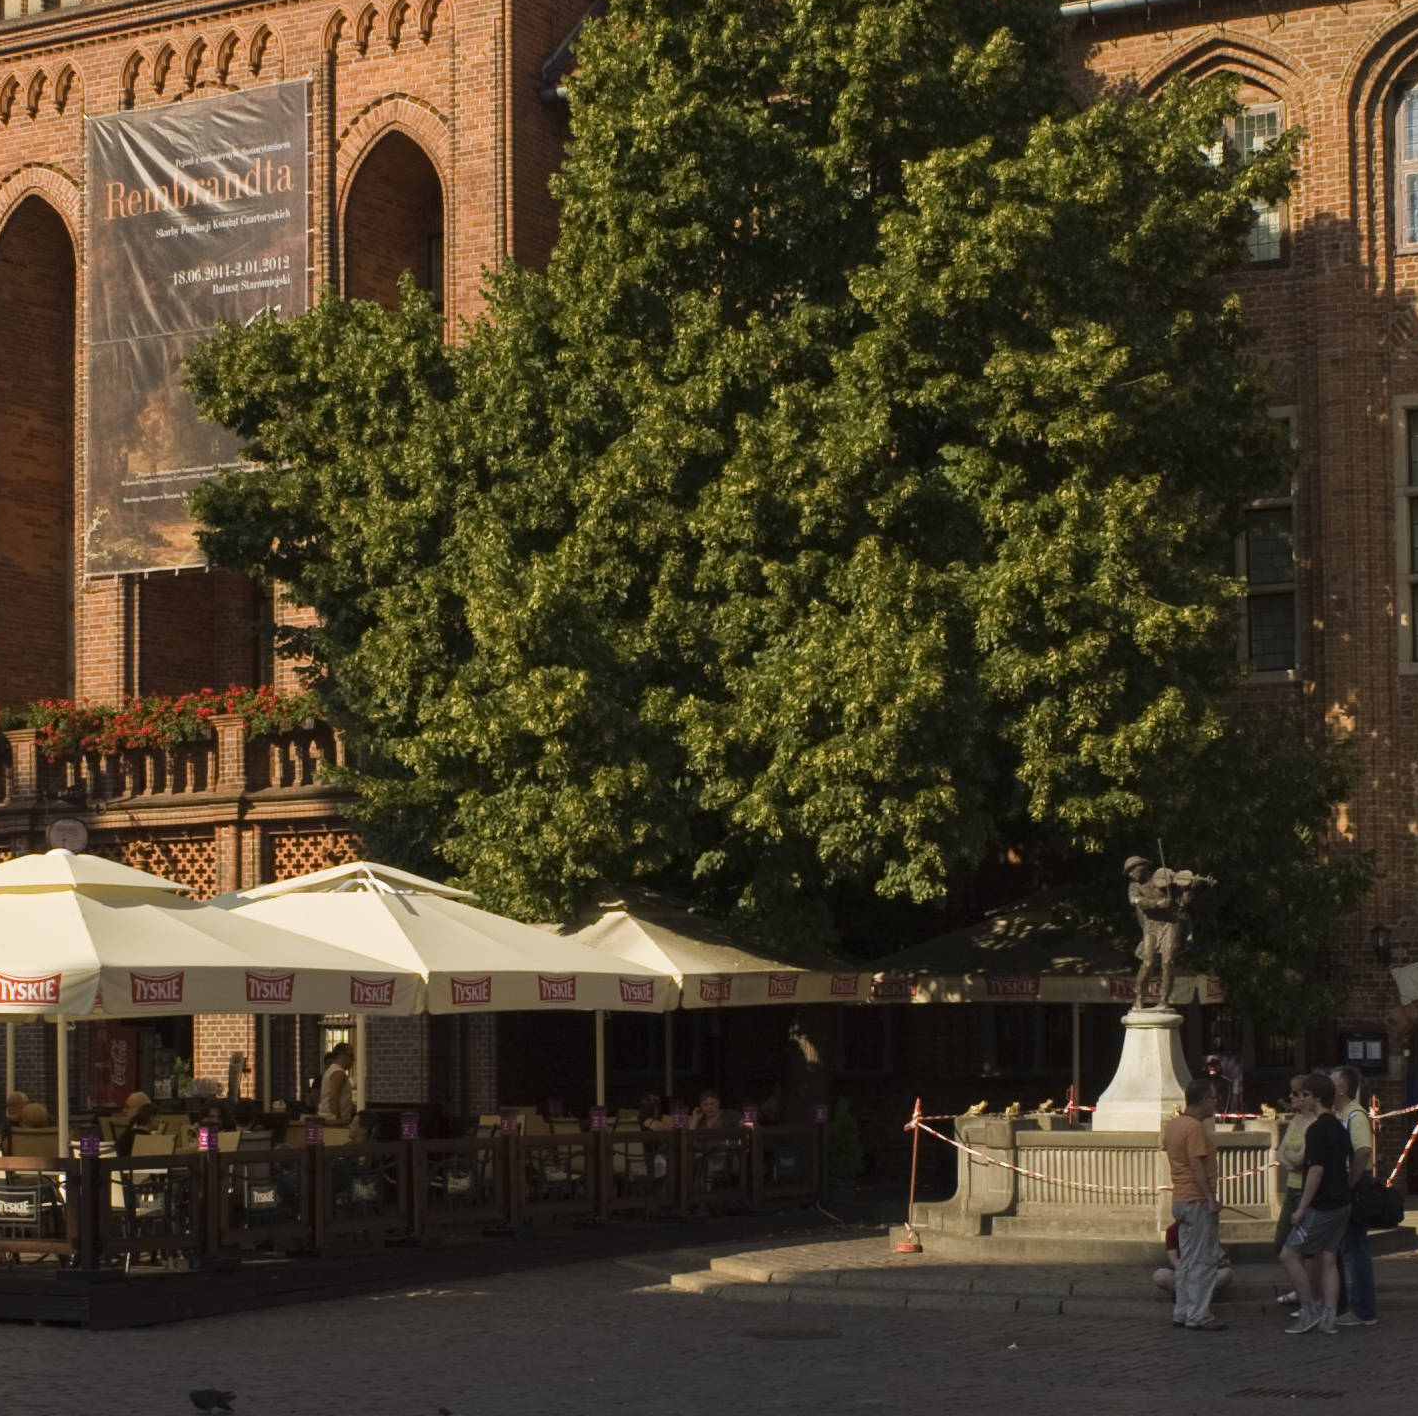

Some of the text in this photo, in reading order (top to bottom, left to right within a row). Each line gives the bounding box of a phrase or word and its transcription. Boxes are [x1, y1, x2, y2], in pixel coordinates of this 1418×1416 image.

[104, 157, 295, 221] Rembrandta
[155, 226, 180, 239] Skarby
[181, 220, 212, 235] Fundacji
[240, 208, 291, 225] Czartoryskich
[172, 255, 291, 287] 18.06.2011-2.01.2012
[212, 274, 291, 296] Ratusz Staromiejski
[134, 978, 181, 1000] TYSKIE
[249, 979, 291, 1000] TYSKIE
[354, 983, 392, 1003] TYSKIE
[454, 981, 490, 1002] TYSKIE
[541, 980, 574, 1000] TYSKIE
[622, 981, 652, 1002] TYSKIE
[701, 983, 730, 1000] TYSKIE
[769, 977, 795, 995] TYSKIE
[876, 980, 915, 997] YSKIE
[989, 979, 1037, 995] TYSKIE
[1112, 980, 1161, 996] TYSIE
[252, 1189, 275, 1203] TYSKIE
